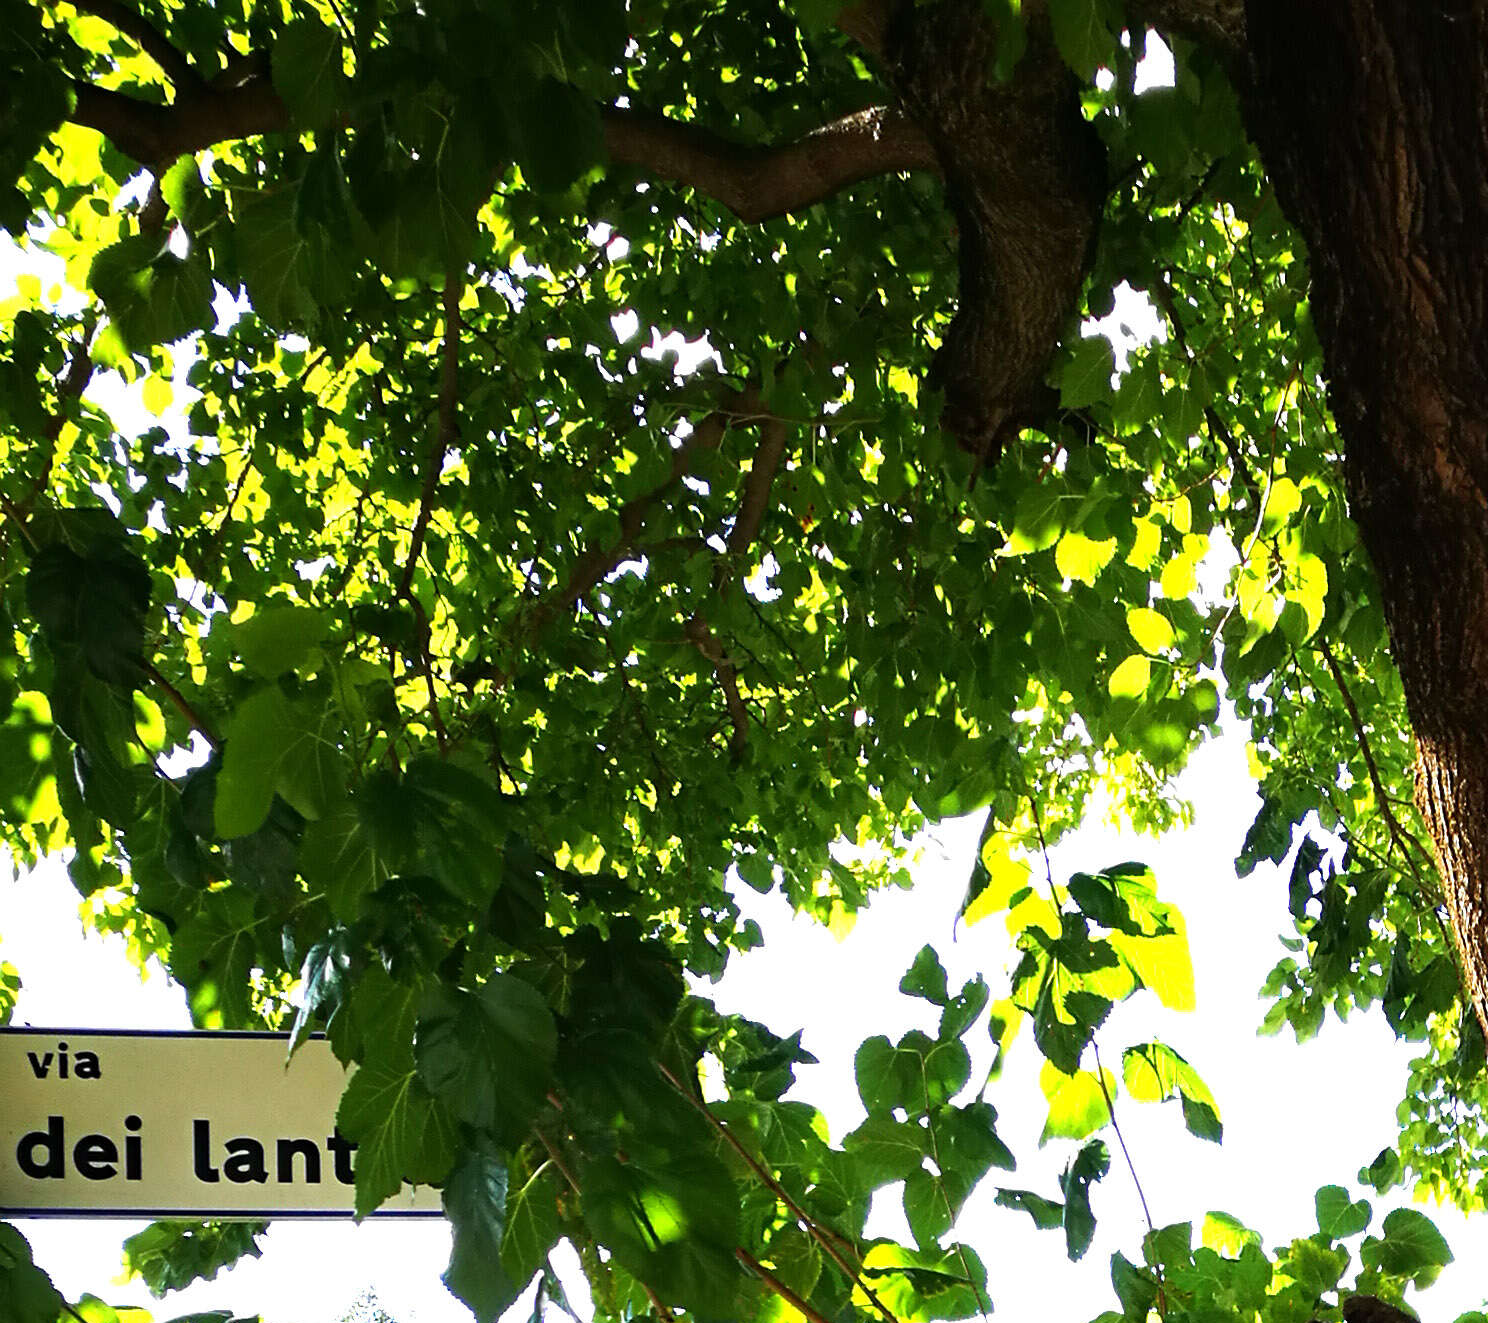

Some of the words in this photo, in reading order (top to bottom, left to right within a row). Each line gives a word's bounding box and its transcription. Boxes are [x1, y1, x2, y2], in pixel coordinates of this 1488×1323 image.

[27, 1041, 102, 1079] via
[16, 1114, 143, 1181] dei
[193, 1119, 443, 1189] lant
